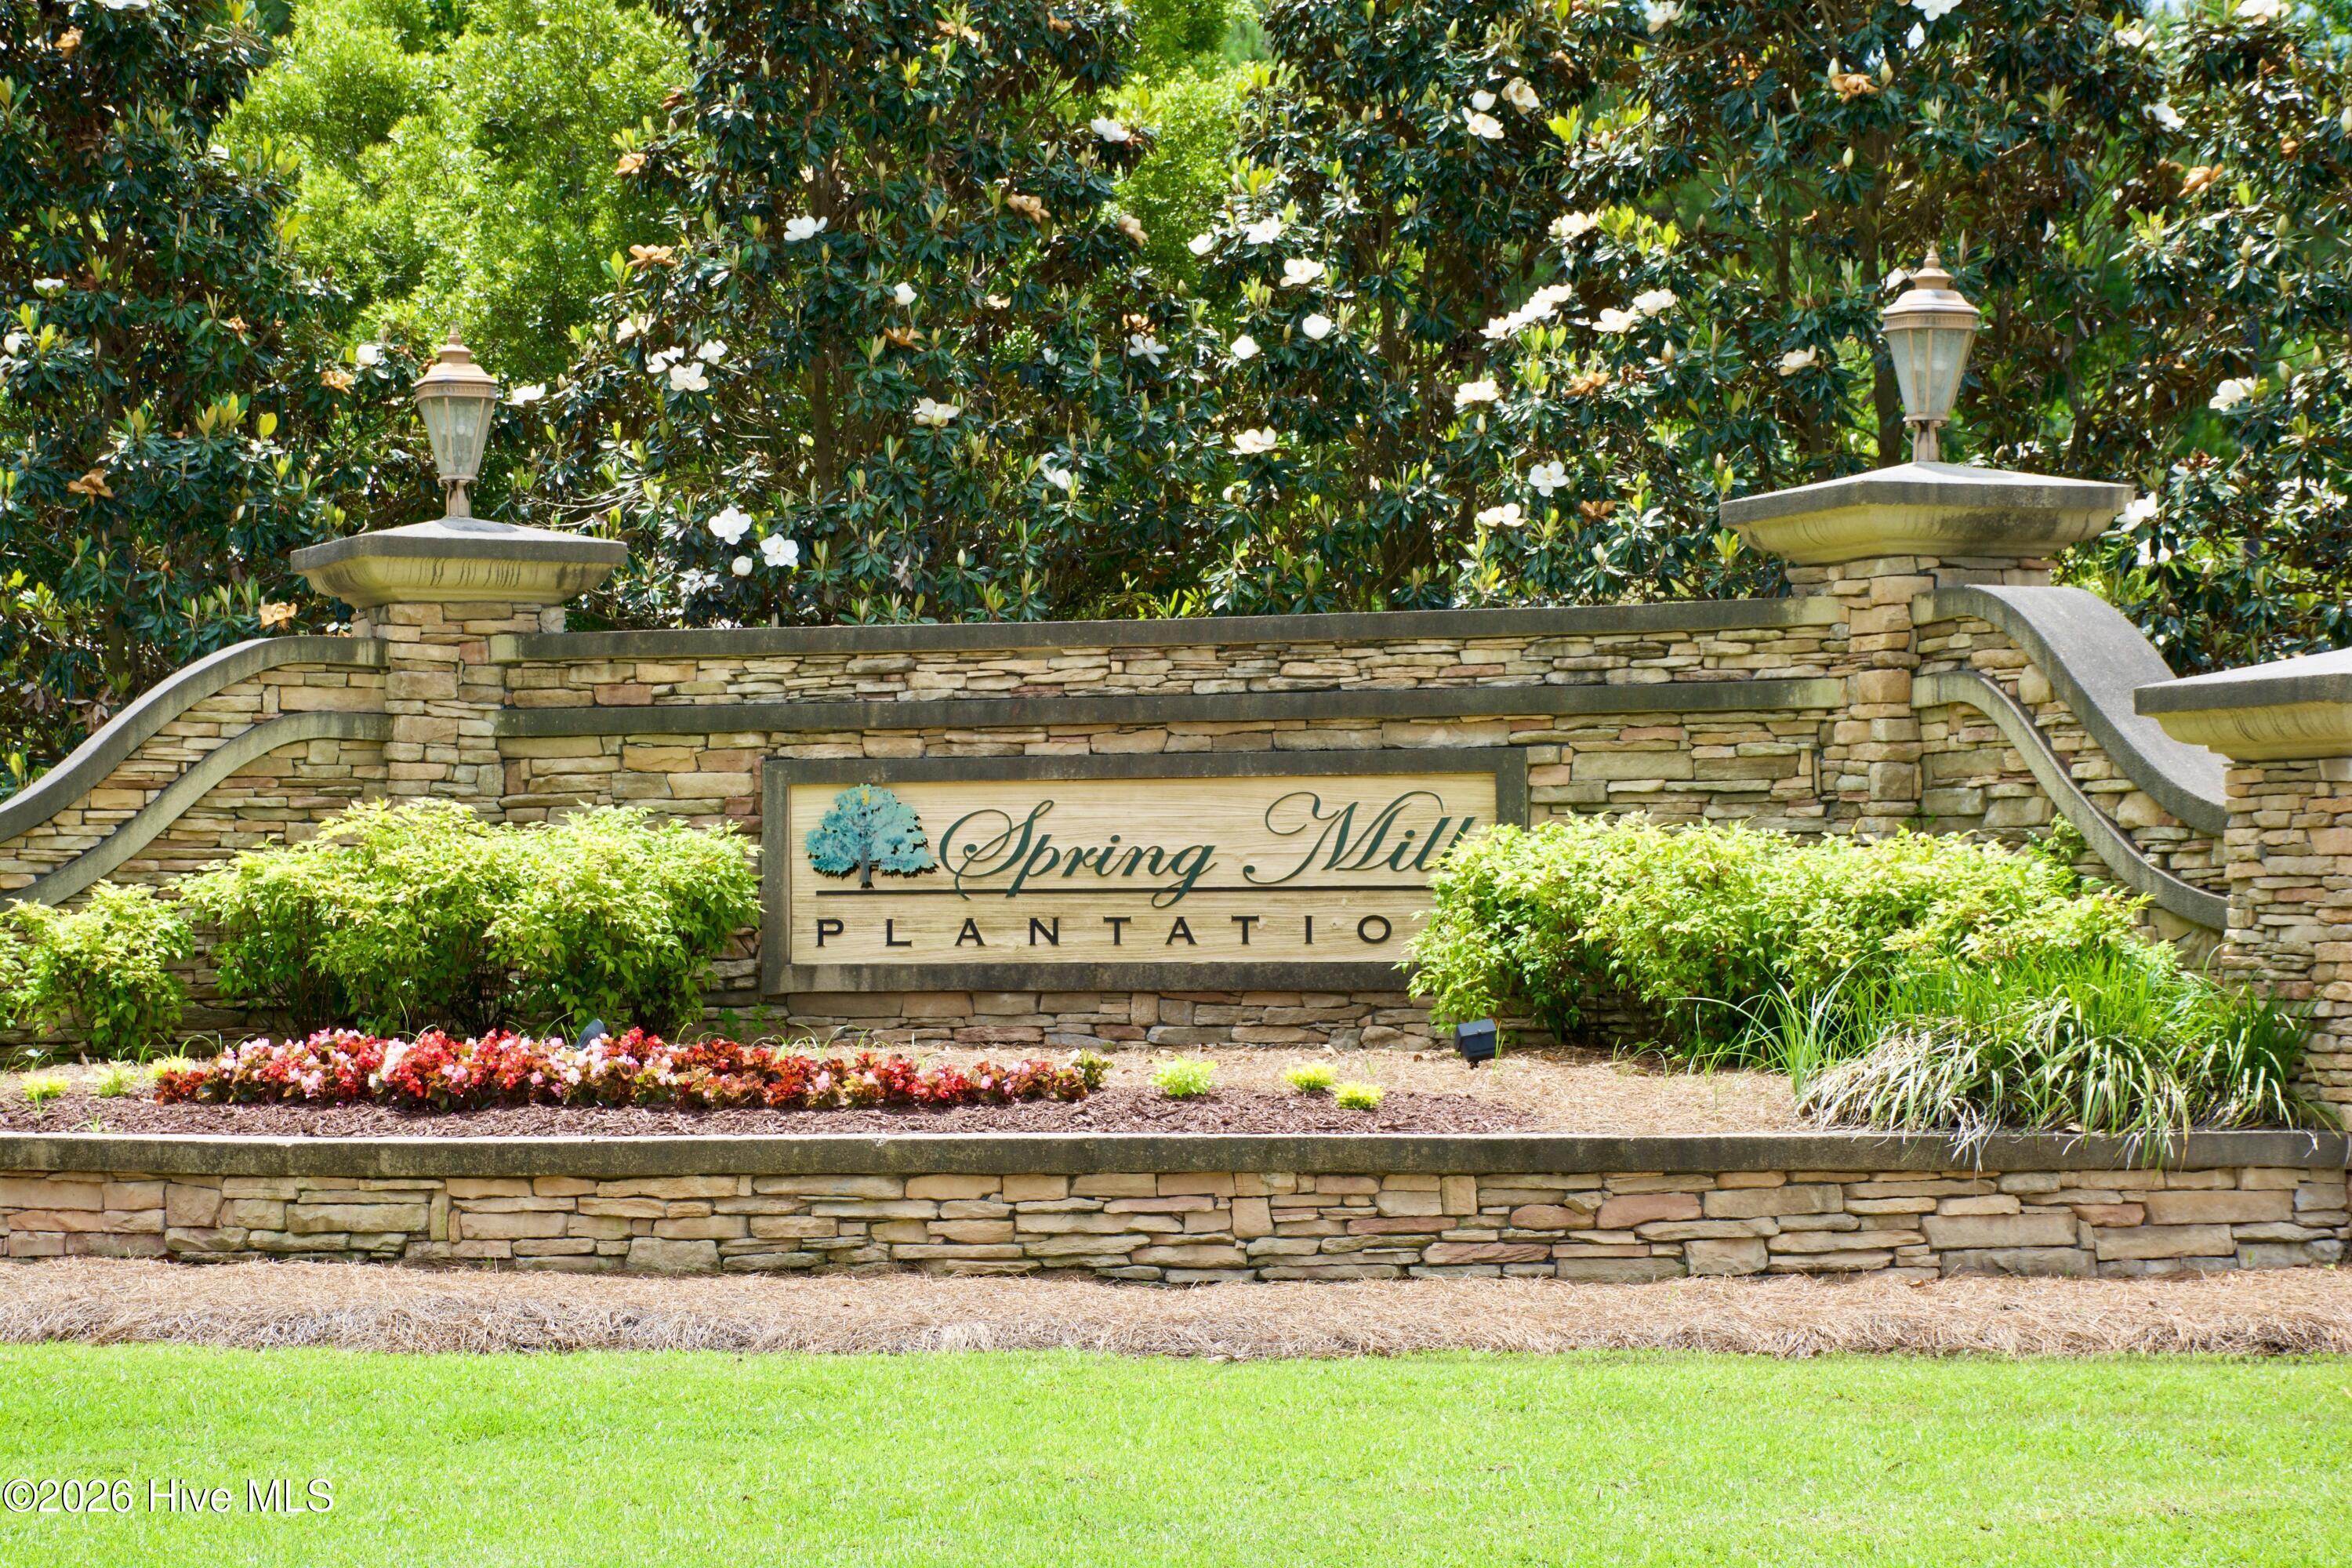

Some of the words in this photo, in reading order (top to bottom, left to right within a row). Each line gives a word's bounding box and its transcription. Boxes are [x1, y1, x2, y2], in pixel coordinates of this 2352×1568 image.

[939, 800, 1218, 908] Spring
[1243, 790, 1475, 884] Mill
[815, 913, 1392, 947] PLANTATIO
